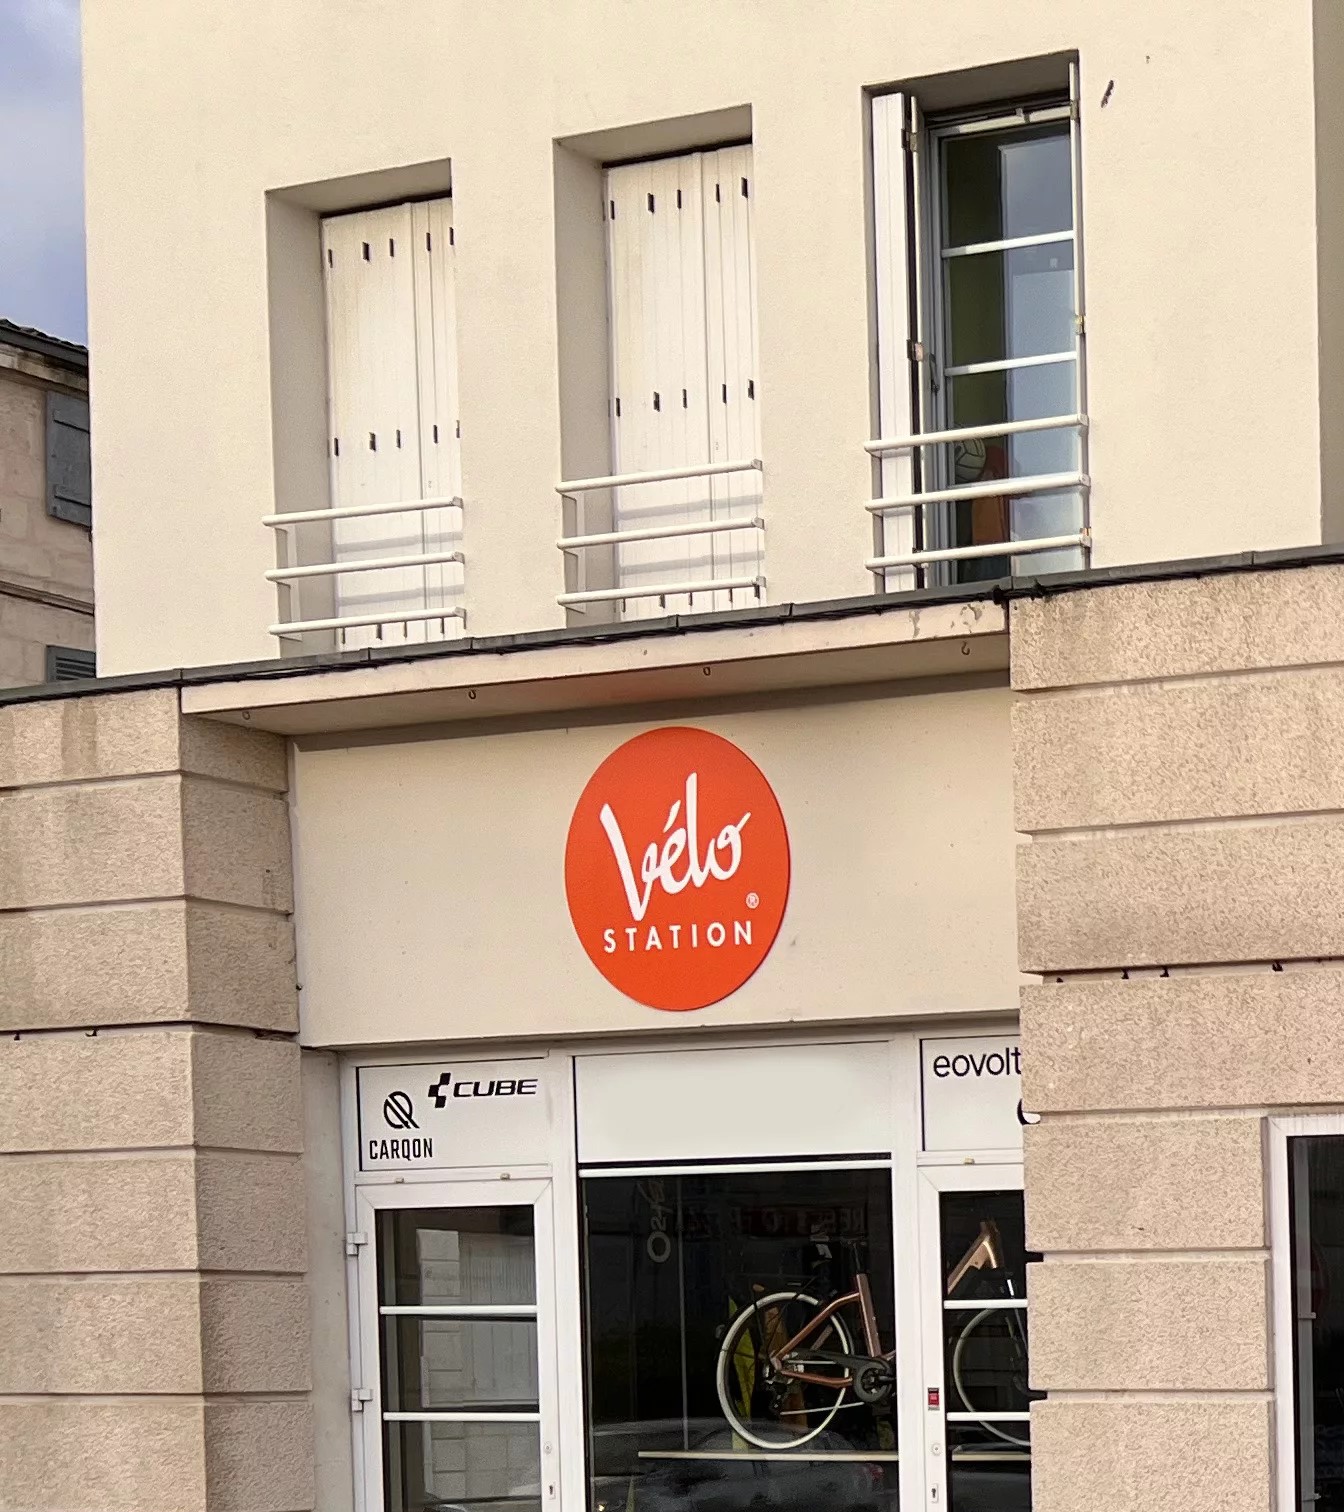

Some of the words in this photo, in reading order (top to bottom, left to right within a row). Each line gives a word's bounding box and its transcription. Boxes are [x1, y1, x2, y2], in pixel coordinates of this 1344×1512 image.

[599, 772, 751, 921] Vélo
[603, 921, 752, 953] STATION
[933, 1047, 1022, 1079] eovolt
[453, 1079, 539, 1098] CUBE
[369, 1138, 433, 1161] CARQON
